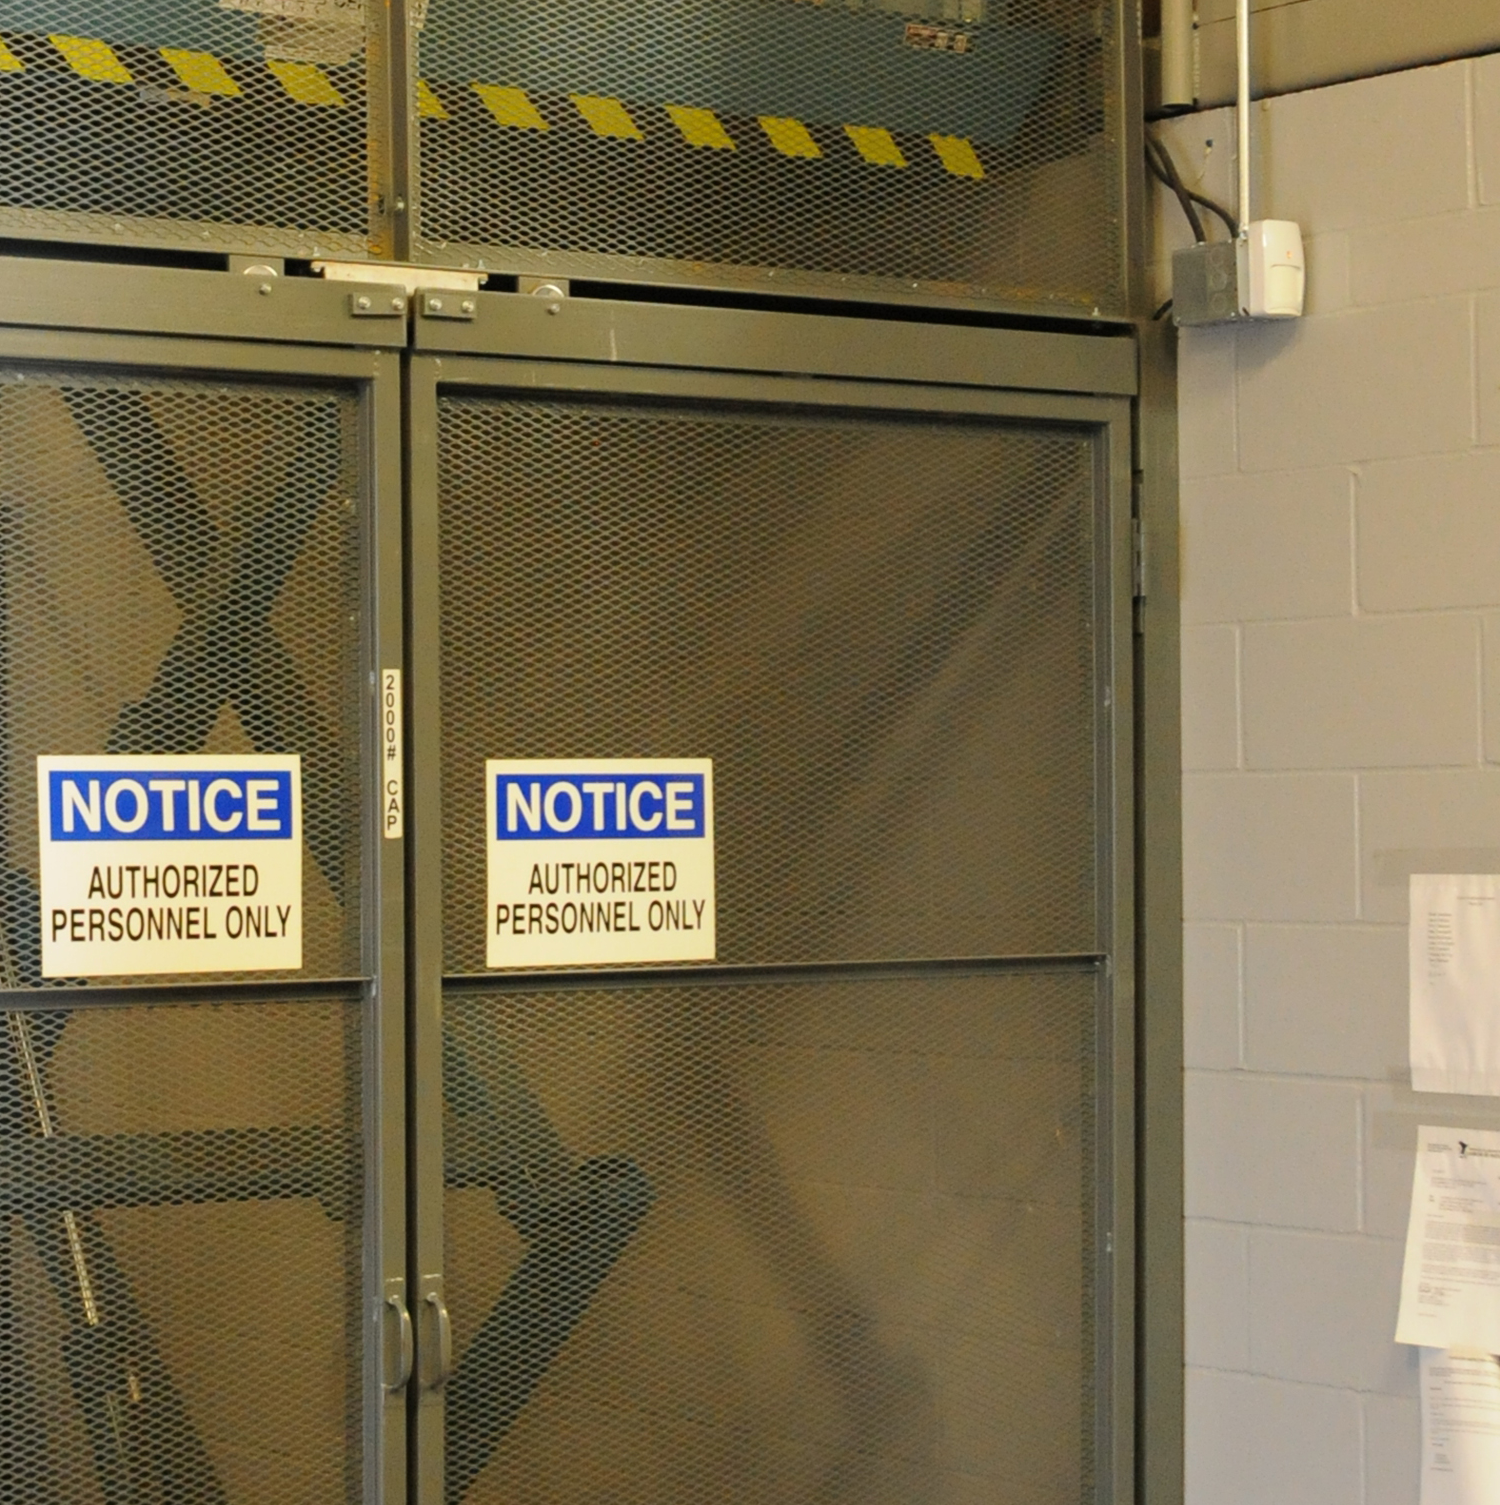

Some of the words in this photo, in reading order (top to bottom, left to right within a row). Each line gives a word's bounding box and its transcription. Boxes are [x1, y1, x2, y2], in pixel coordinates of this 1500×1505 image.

[385, 674, 397, 761] 2000#
[61, 778, 281, 833] NOTICE
[386, 780, 400, 831] CAP
[506, 781, 696, 833] NOTICE
[88, 864, 260, 900] AUTHORIZED
[528, 861, 678, 895] AUTHORIZED
[51, 906, 217, 943] PERSONNEL
[225, 904, 292, 939] ONLY
[496, 901, 641, 936] PERSONNEL
[648, 899, 706, 932] ONLY
